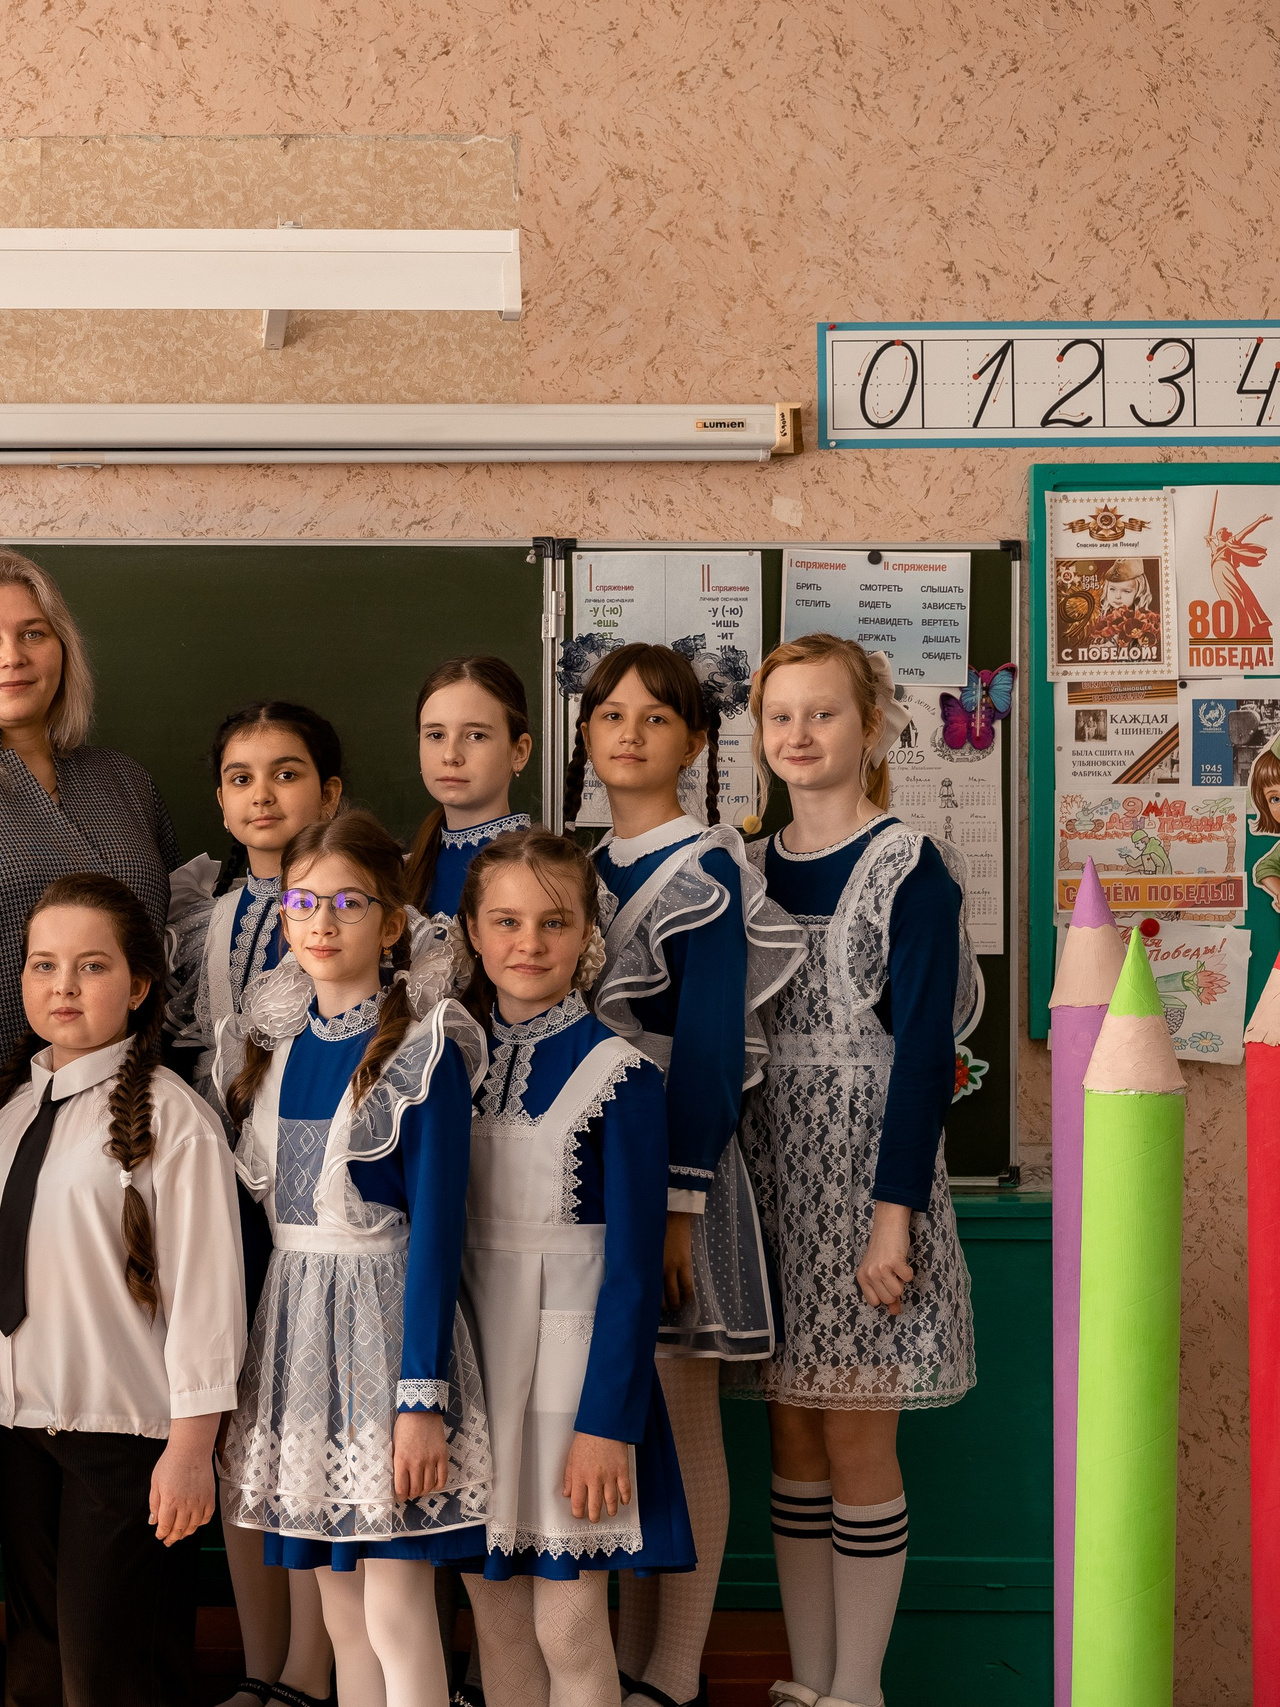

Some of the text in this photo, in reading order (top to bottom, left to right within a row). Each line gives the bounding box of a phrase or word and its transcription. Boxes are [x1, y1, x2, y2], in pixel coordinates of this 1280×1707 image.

[860, 337, 1280, 429] 0 1 2 3 4
[795, 560, 847, 571] спряжение
[892, 562, 947, 573] спряжение
[1082, 574, 1098, 582] 1941
[595, 584, 635, 593] спряжение
[711, 584, 750, 593] спряжение
[796, 582, 822, 591] БРИТЬ
[859, 583, 903, 592] СМОТРЕТЬ
[920, 585, 964, 594] СЛЫШАТЬ
[1082, 582, 1100, 590] 1945
[795, 599, 831, 608] СТЕЛИТЬ
[858, 600, 892, 609] ВИДЕТЬ
[921, 602, 967, 611] ЗАВИСЕТЬ
[592, 619, 619, 628] -ешь
[858, 617, 913, 627] НЕНАВИДЕТЬ
[921, 618, 960, 627] ВЕРТЕТЬ
[1188, 599, 1234, 639] 80
[857, 633, 897, 642] ДЕРЖАТЬ
[922, 635, 961, 644] ДЫШАТЬ
[921, 651, 962, 661] ОБИДЕТЬ
[1061, 645, 1158, 661] С ПОБЕДОЙ!
[1189, 646, 1274, 670] ПОБЕДА!
[898, 667, 925, 677] ГНАТЬ
[1110, 714, 1168, 726] КАЖДАЯ
[1121, 727, 1164, 735] ШИНЕЛЬ
[888, 750, 925, 765] 2025
[1071, 749, 1135, 757] БЫЛА СШИТА НА
[1071, 760, 1127, 768] УЛЬЯНОВСКИХ
[1200, 764, 1222, 772] 1945
[1200, 776, 1222, 784] 2020
[1122, 796, 1187, 818] 9 МАЯ
[1105, 812, 1224, 833] ДЕНЬ ПОБЕДЫ
[1147, 882, 1236, 905] ПОБЕДЫ!
[1148, 938, 1227, 962] Победы!
